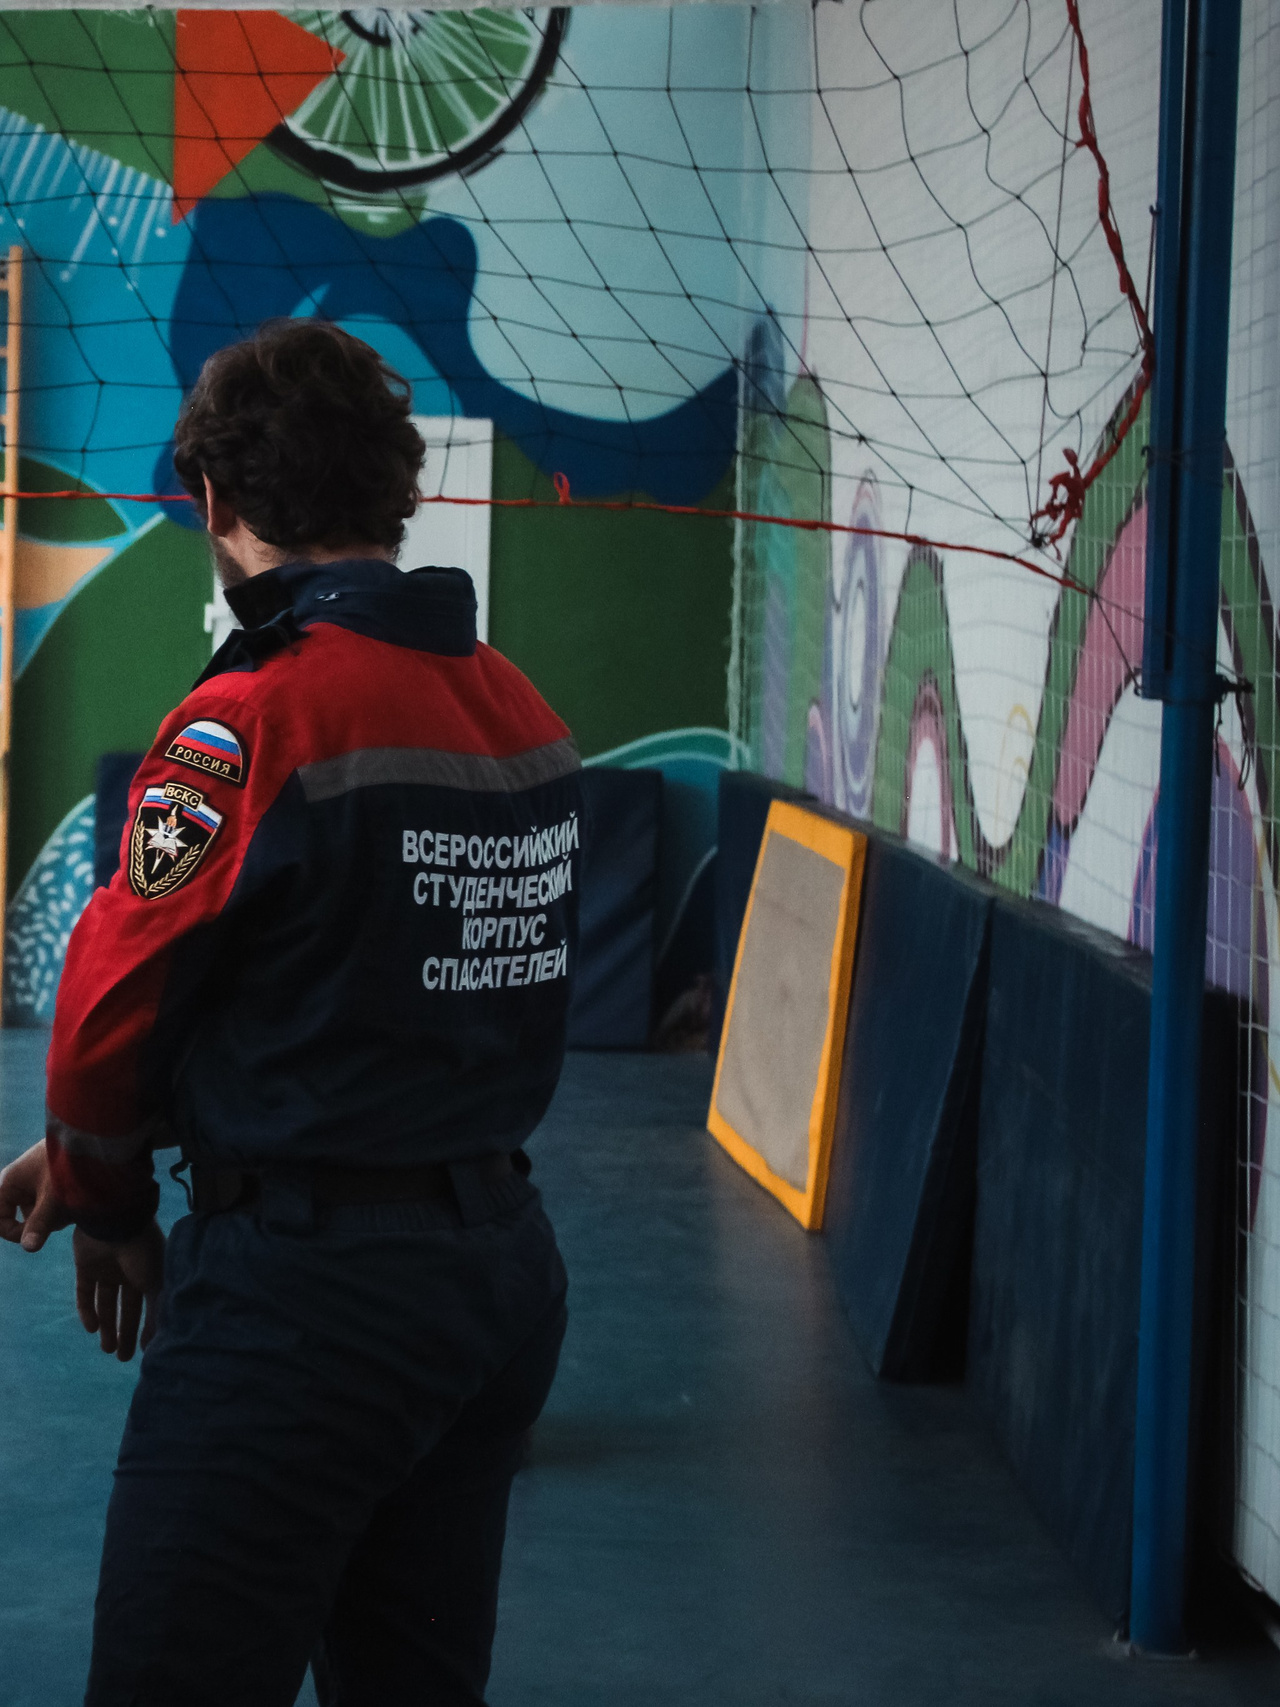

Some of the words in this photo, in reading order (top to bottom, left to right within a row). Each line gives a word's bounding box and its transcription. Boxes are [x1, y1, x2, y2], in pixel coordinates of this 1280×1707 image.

[175, 746, 231, 774] РОССИЯ
[166, 786, 199, 806] ВСКС
[402, 811, 579, 869] ВСЕРОССИЙСКИЙ
[413, 853, 572, 916] СТУДЕНЧЕСКИЙ
[462, 913, 547, 950] КОРПУС
[422, 938, 567, 991] СПАСАТЕЛЕЙ
